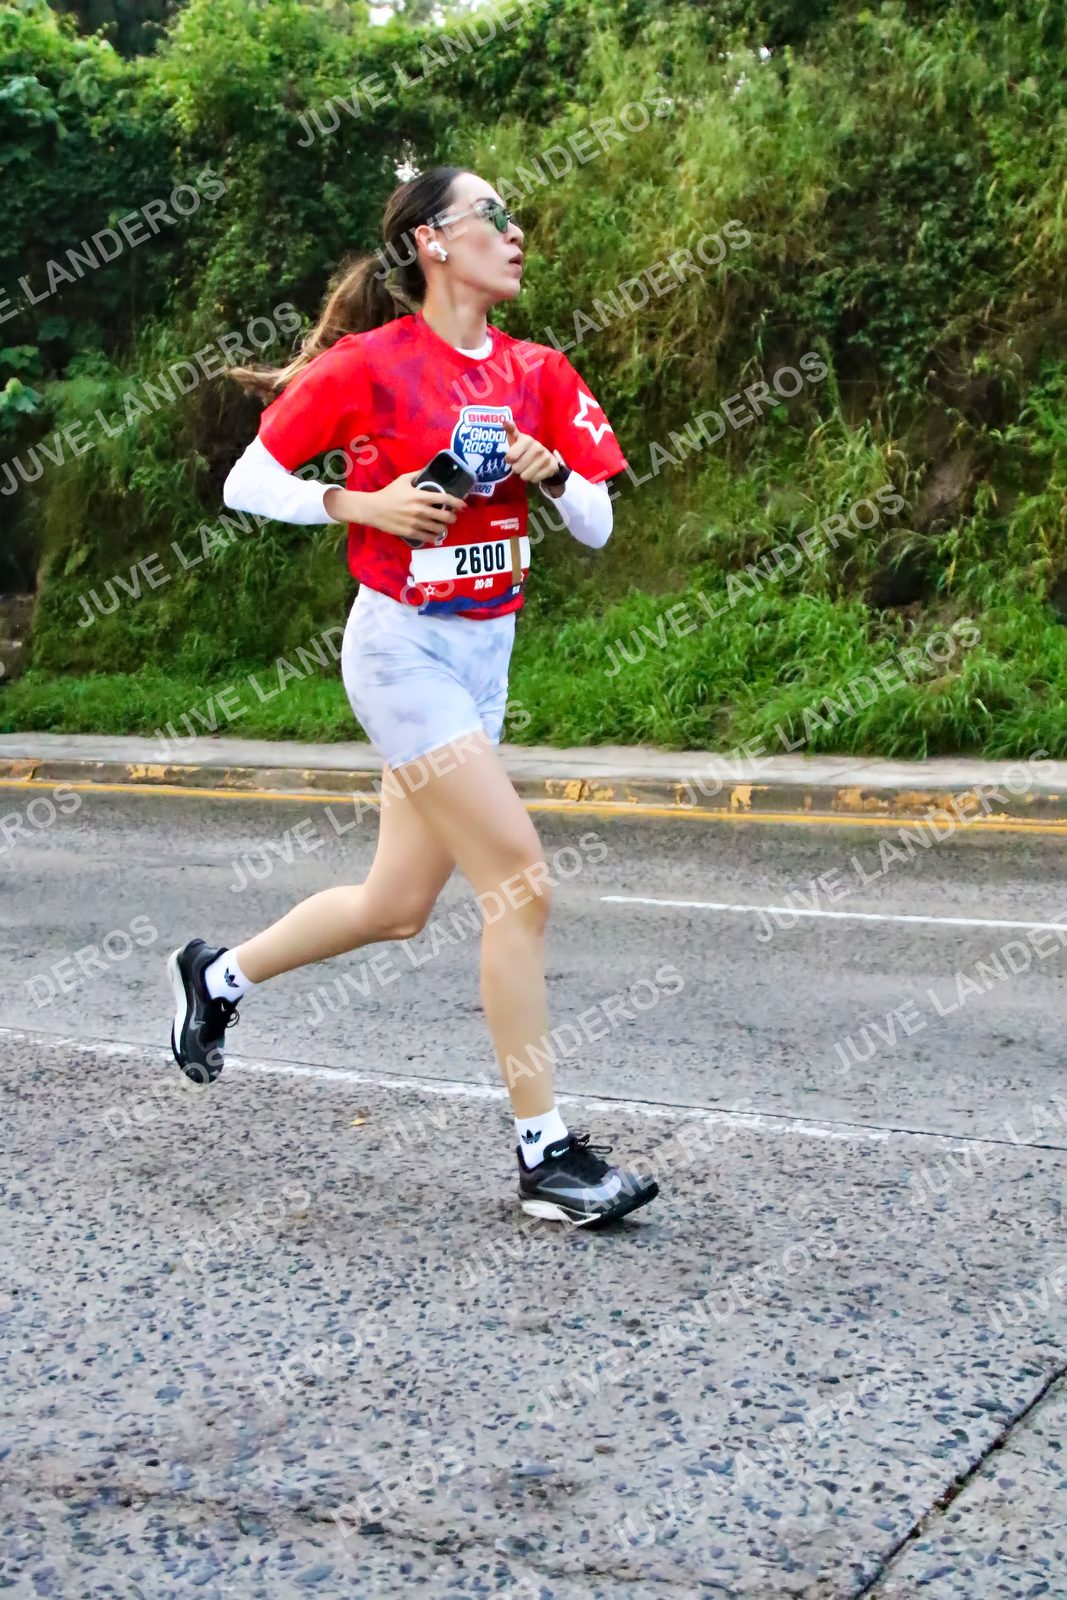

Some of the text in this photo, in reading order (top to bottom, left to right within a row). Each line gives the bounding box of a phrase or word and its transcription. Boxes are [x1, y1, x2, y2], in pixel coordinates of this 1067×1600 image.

[468, 414, 506, 423] BIMBO
[470, 428, 507, 443] Global
[462, 439, 493, 454] Race
[472, 484, 492, 494] 026
[455, 543, 505, 575] 2600
